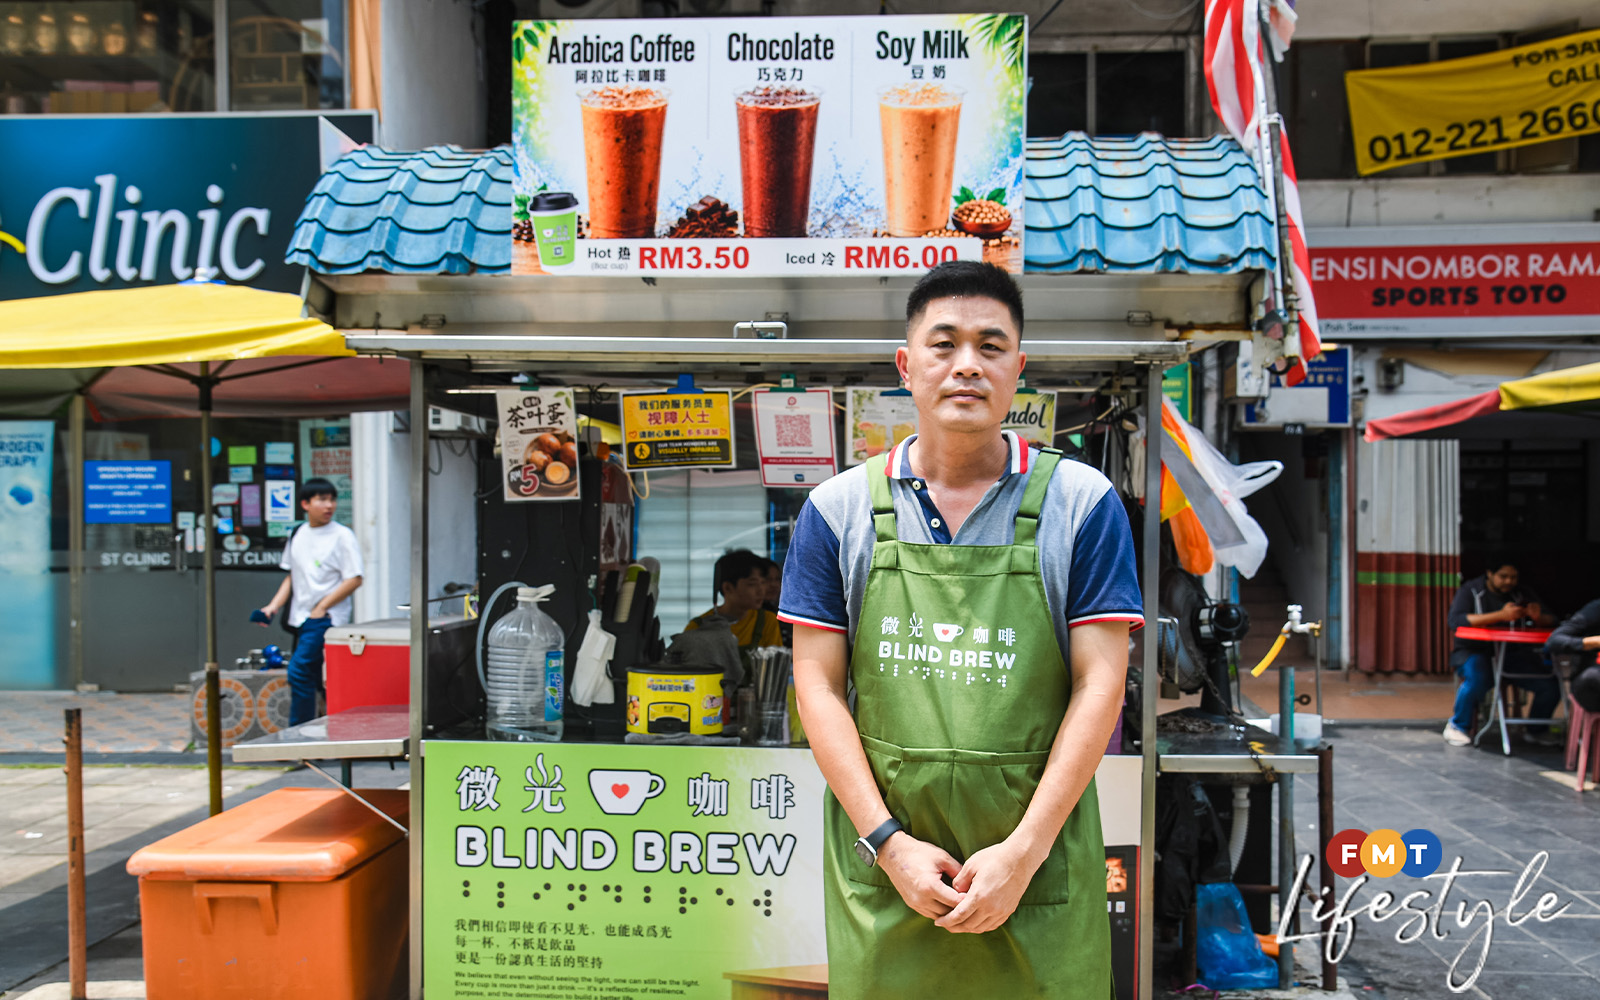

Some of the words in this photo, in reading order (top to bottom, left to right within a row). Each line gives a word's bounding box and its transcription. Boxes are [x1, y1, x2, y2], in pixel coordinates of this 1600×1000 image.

[548, 34, 624, 64] Arabica
[630, 33, 695, 63] Coffee
[728, 32, 834, 62] Chocolate
[876, 31, 915, 65] Soy
[923, 30, 969, 59] Milk
[575, 68, 666, 84] 阿拉比卡咖啡
[757, 66, 804, 82] 巧克力
[911, 65, 947, 79] 豆奶
[1368, 115, 1511, 163] 012-221
[25, 173, 272, 284] Clinic
[588, 247, 611, 259] Hot
[618, 246, 631, 260] 热
[638, 246, 750, 269] RM3.50
[786, 252, 815, 264] Iced
[821, 251, 836, 266] 冷
[844, 245, 958, 269] RM6.00
[1381, 254, 1520, 280] NOMBOR
[1372, 286, 1479, 307] SPORTS
[1491, 284, 1567, 305] TOTO
[506, 402, 566, 428] 茶叶蛋
[638, 398, 714, 411] 我们的服务员是
[647, 410, 710, 425] 视障人士
[100, 552, 120, 566] ST
[122, 552, 171, 566] CLINIC
[221, 552, 241, 566] ST
[243, 551, 283, 566] CLINI
[881, 612, 923, 638] 微光
[973, 626, 1016, 647] 咖啡
[878, 640, 943, 663] BLIND
[949, 649, 1017, 670] BREW
[456, 752, 566, 814] 微光
[687, 772, 796, 819] 咖啡
[455, 825, 618, 871] BLIND
[633, 830, 797, 876] BREW
[455, 980, 474, 988] Every
[519, 981, 535, 989] than
[536, 982, 550, 991] just
[557, 983, 576, 991] drink
[605, 986, 639, 994] reflection
[556, 975, 579, 983] seeing
